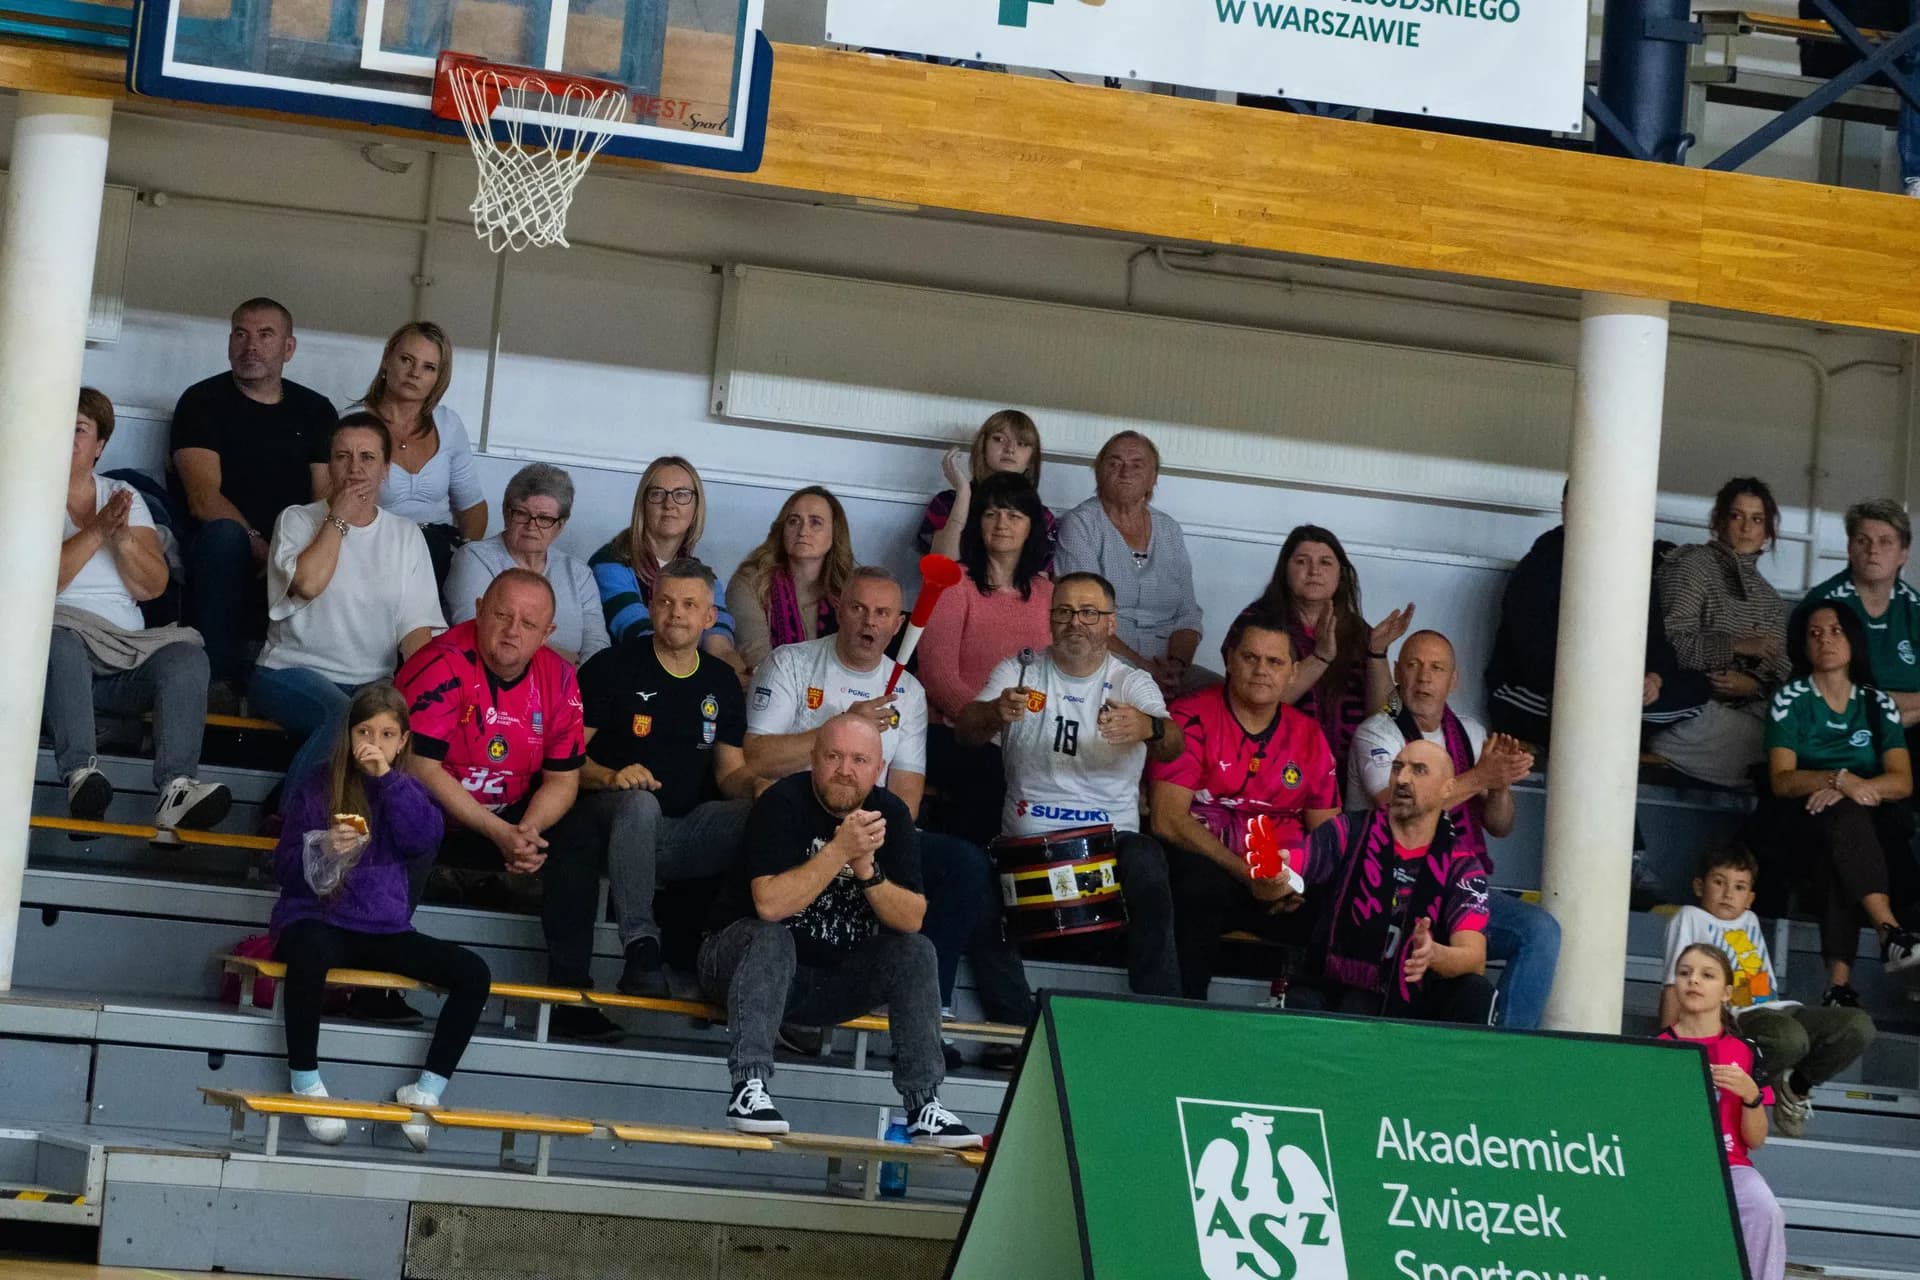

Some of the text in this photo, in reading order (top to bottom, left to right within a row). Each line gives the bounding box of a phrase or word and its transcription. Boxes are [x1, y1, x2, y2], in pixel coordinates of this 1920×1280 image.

[1215, 0, 1421, 48] W WARSZAWIE
[682, 112, 729, 131] Sport
[1054, 715, 1079, 757] 18
[462, 766, 514, 794] 32
[1376, 1116, 1625, 1177] Akademicki
[1382, 1183, 1567, 1244] Związek
